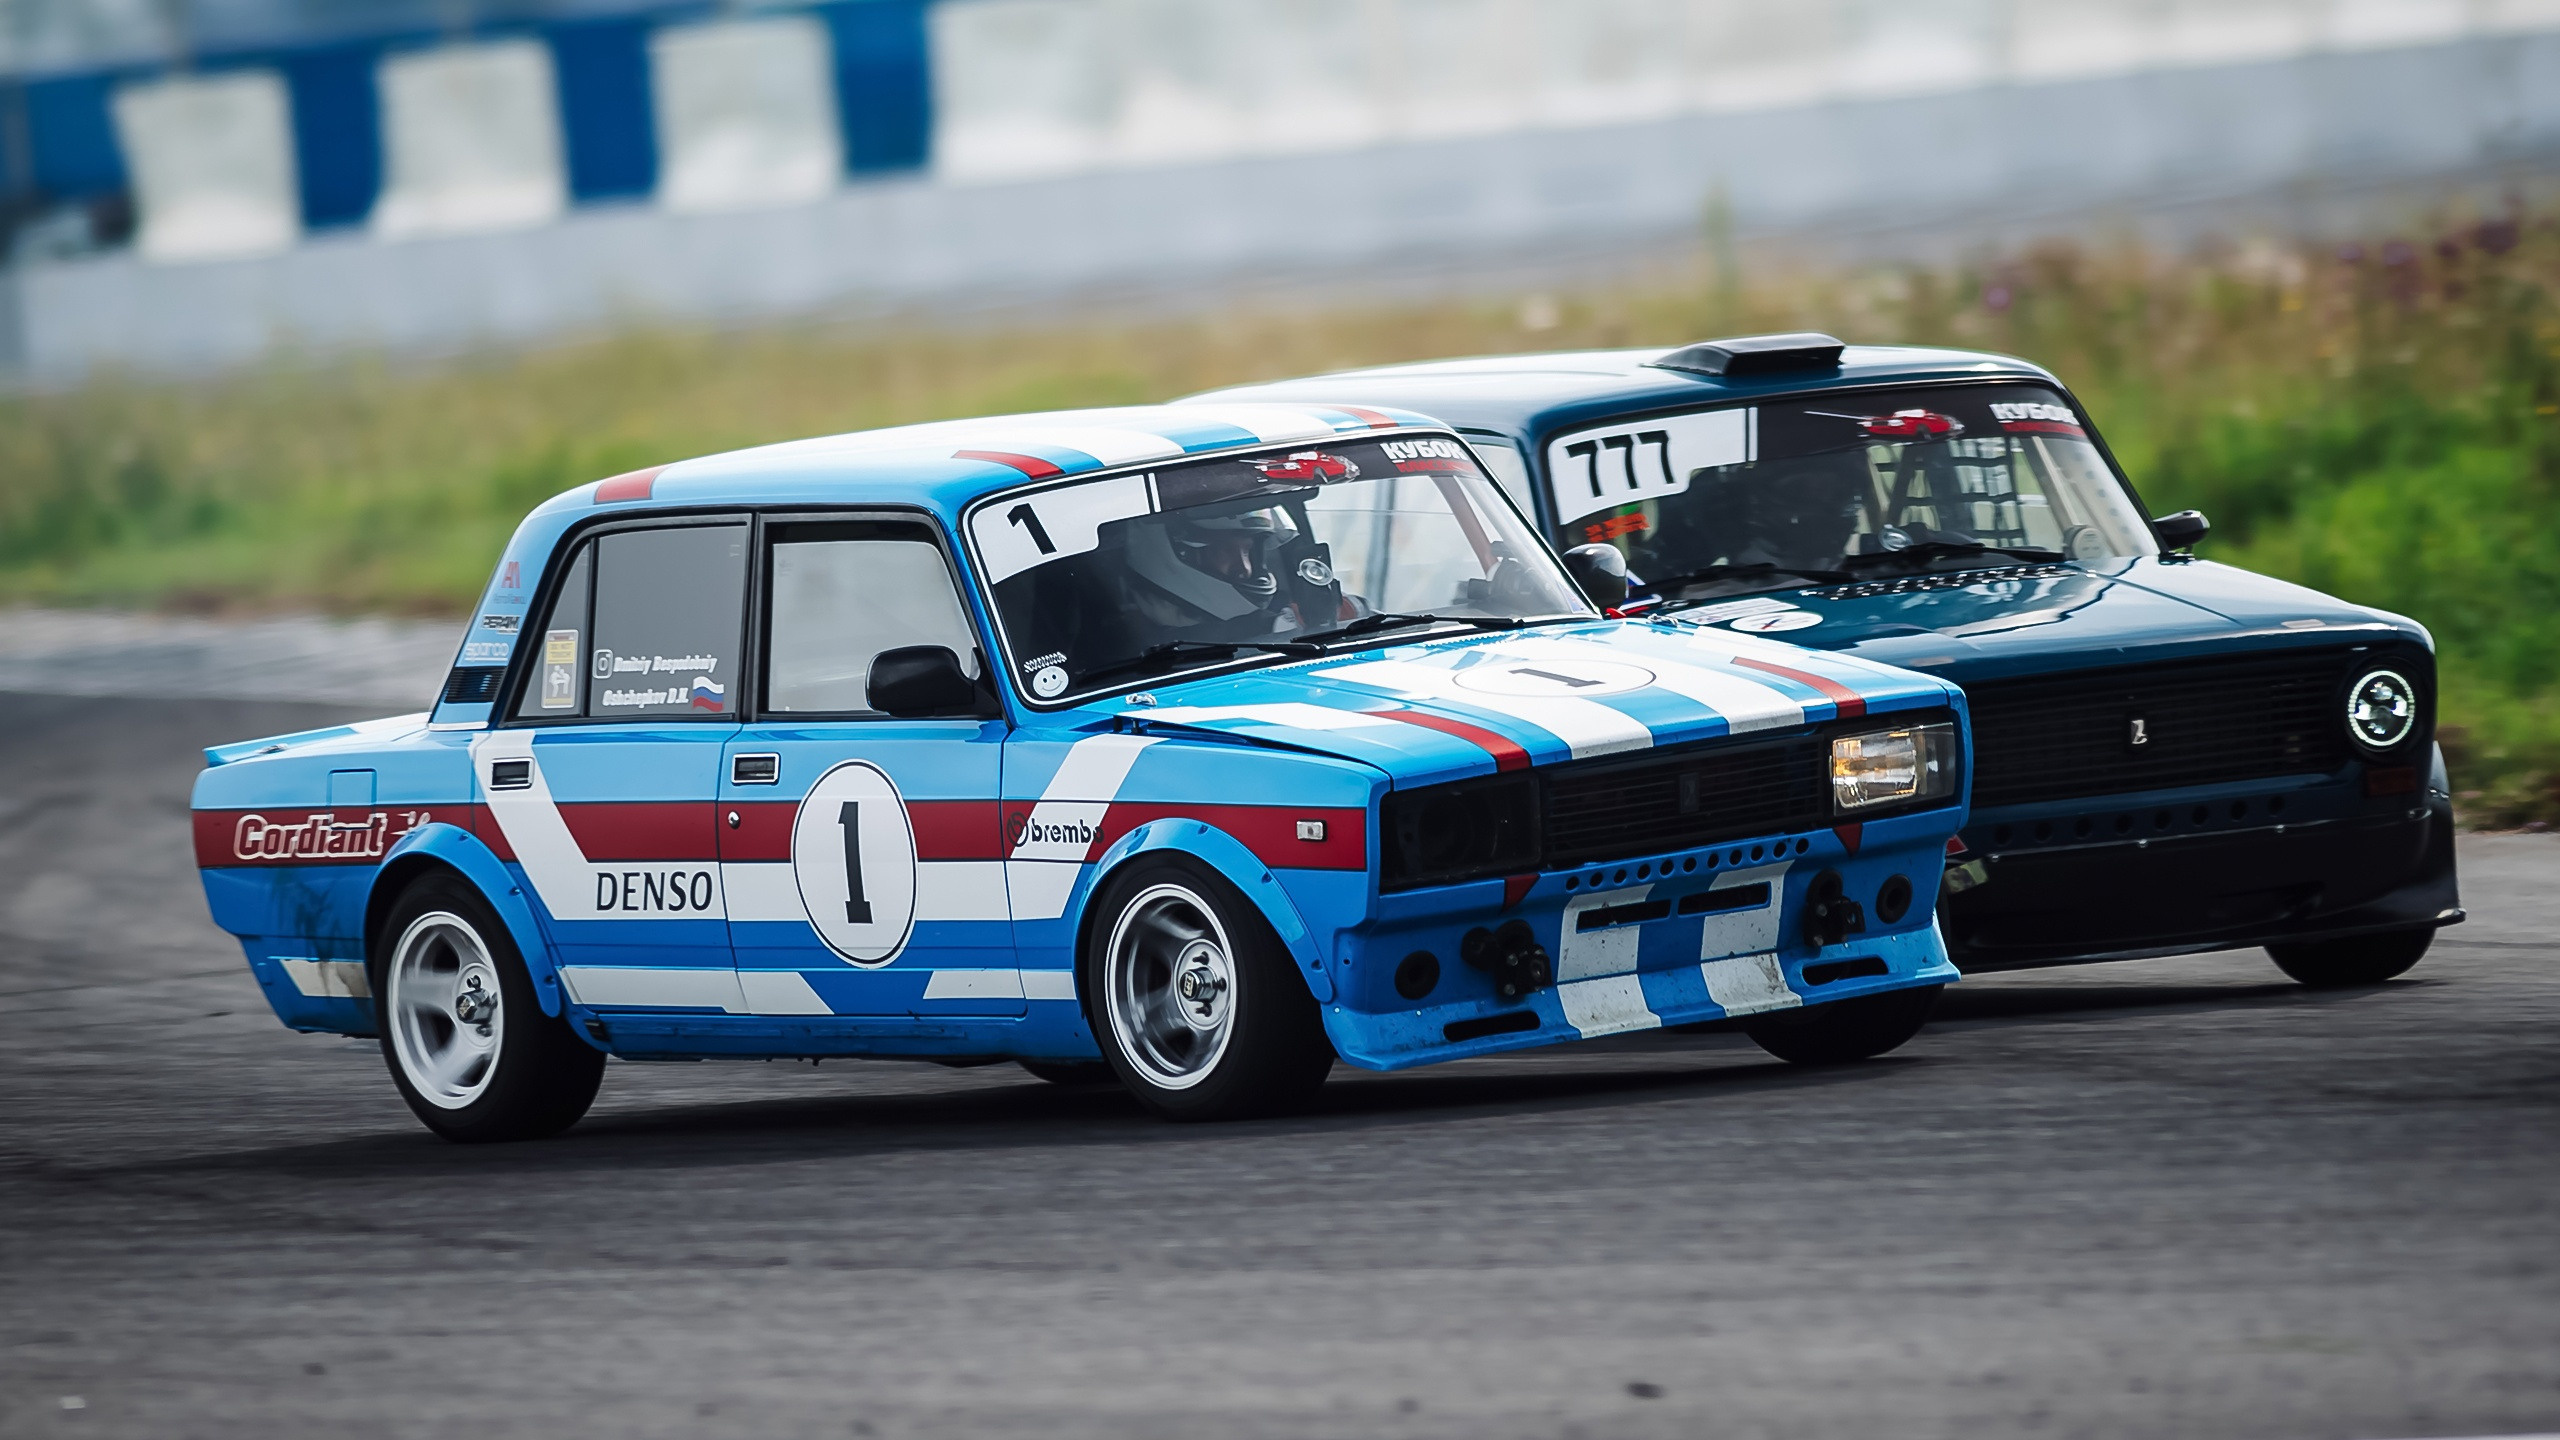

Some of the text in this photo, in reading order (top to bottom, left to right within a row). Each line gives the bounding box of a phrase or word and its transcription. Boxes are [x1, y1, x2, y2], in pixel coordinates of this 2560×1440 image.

[1379, 441, 1469, 461] КУБОК
[1565, 430, 1675, 498] 777
[1007, 503, 1058, 556] 1
[1508, 668, 1606, 687] 1
[233, 812, 387, 860] Cordiant
[1031, 818, 1105, 844] brembo
[838, 801, 873, 924] 1
[596, 871, 713, 911] DENSO
